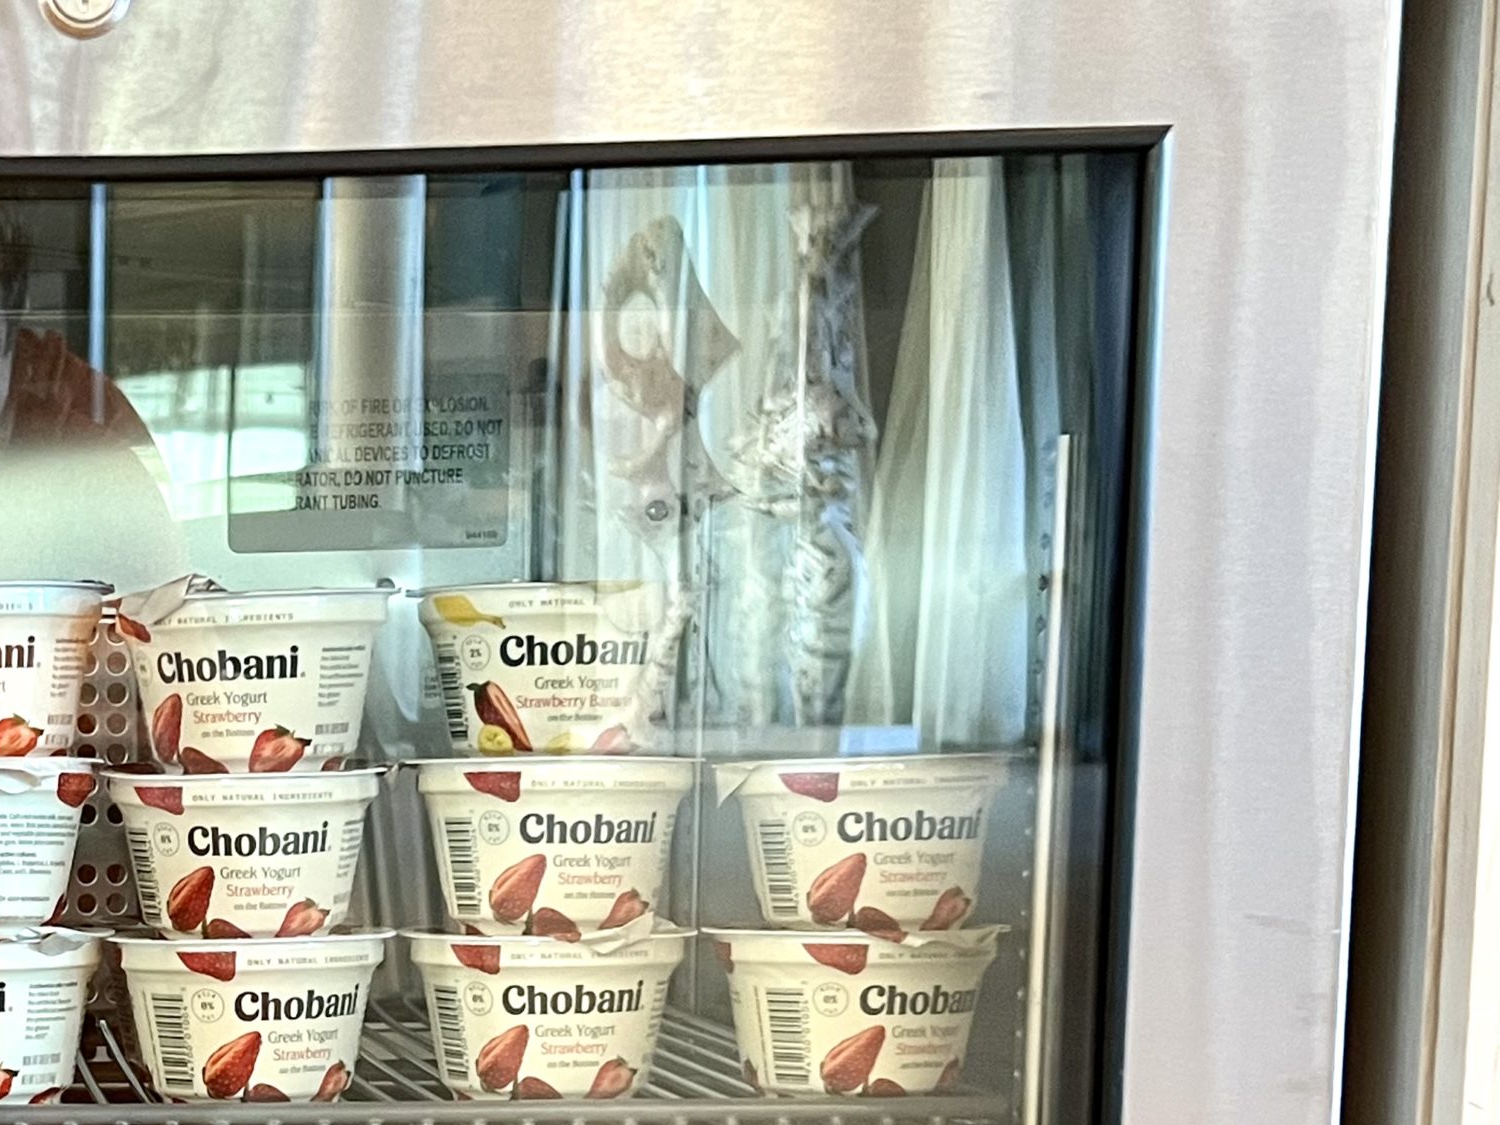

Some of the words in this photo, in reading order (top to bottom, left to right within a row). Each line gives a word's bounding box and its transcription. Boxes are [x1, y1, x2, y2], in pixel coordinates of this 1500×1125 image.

[361, 398, 391, 414] FIRE
[477, 418, 503, 436] NOT
[354, 446, 409, 462] DEVICES
[432, 444, 490, 461] DEFROST
[344, 471, 362, 486] DO
[365, 470, 391, 486] NOT
[395, 468, 463, 485] PUNCTURE
[500, 631, 649, 667] Chobani
[157, 645, 299, 683] Chobani
[187, 692, 220, 705] Greek
[224, 691, 267, 706] Yogurt
[516, 696, 585, 709] Strawberry
[193, 711, 262, 725] Strawberry
[520, 812, 656, 844] Chobani
[838, 809, 982, 842] Chobani
[188, 821, 328, 856] Chobani
[553, 855, 590, 867] Greek
[595, 855, 632, 868] Yogurt
[220, 866, 257, 879] Greek
[262, 866, 301, 880] Yogurt
[558, 873, 622, 886] Strawberry
[226, 885, 294, 897] Strawberry
[235, 983, 359, 1021] Chobani
[502, 980, 643, 1015] Chobani
[268, 1031, 302, 1043] Greek
[307, 1029, 338, 1043] Yogurt
[535, 1025, 572, 1037] Greek
[577, 1024, 615, 1038] Yogurt
[273, 1048, 332, 1061] Strawberry
[541, 1042, 608, 1054] Strawberry
